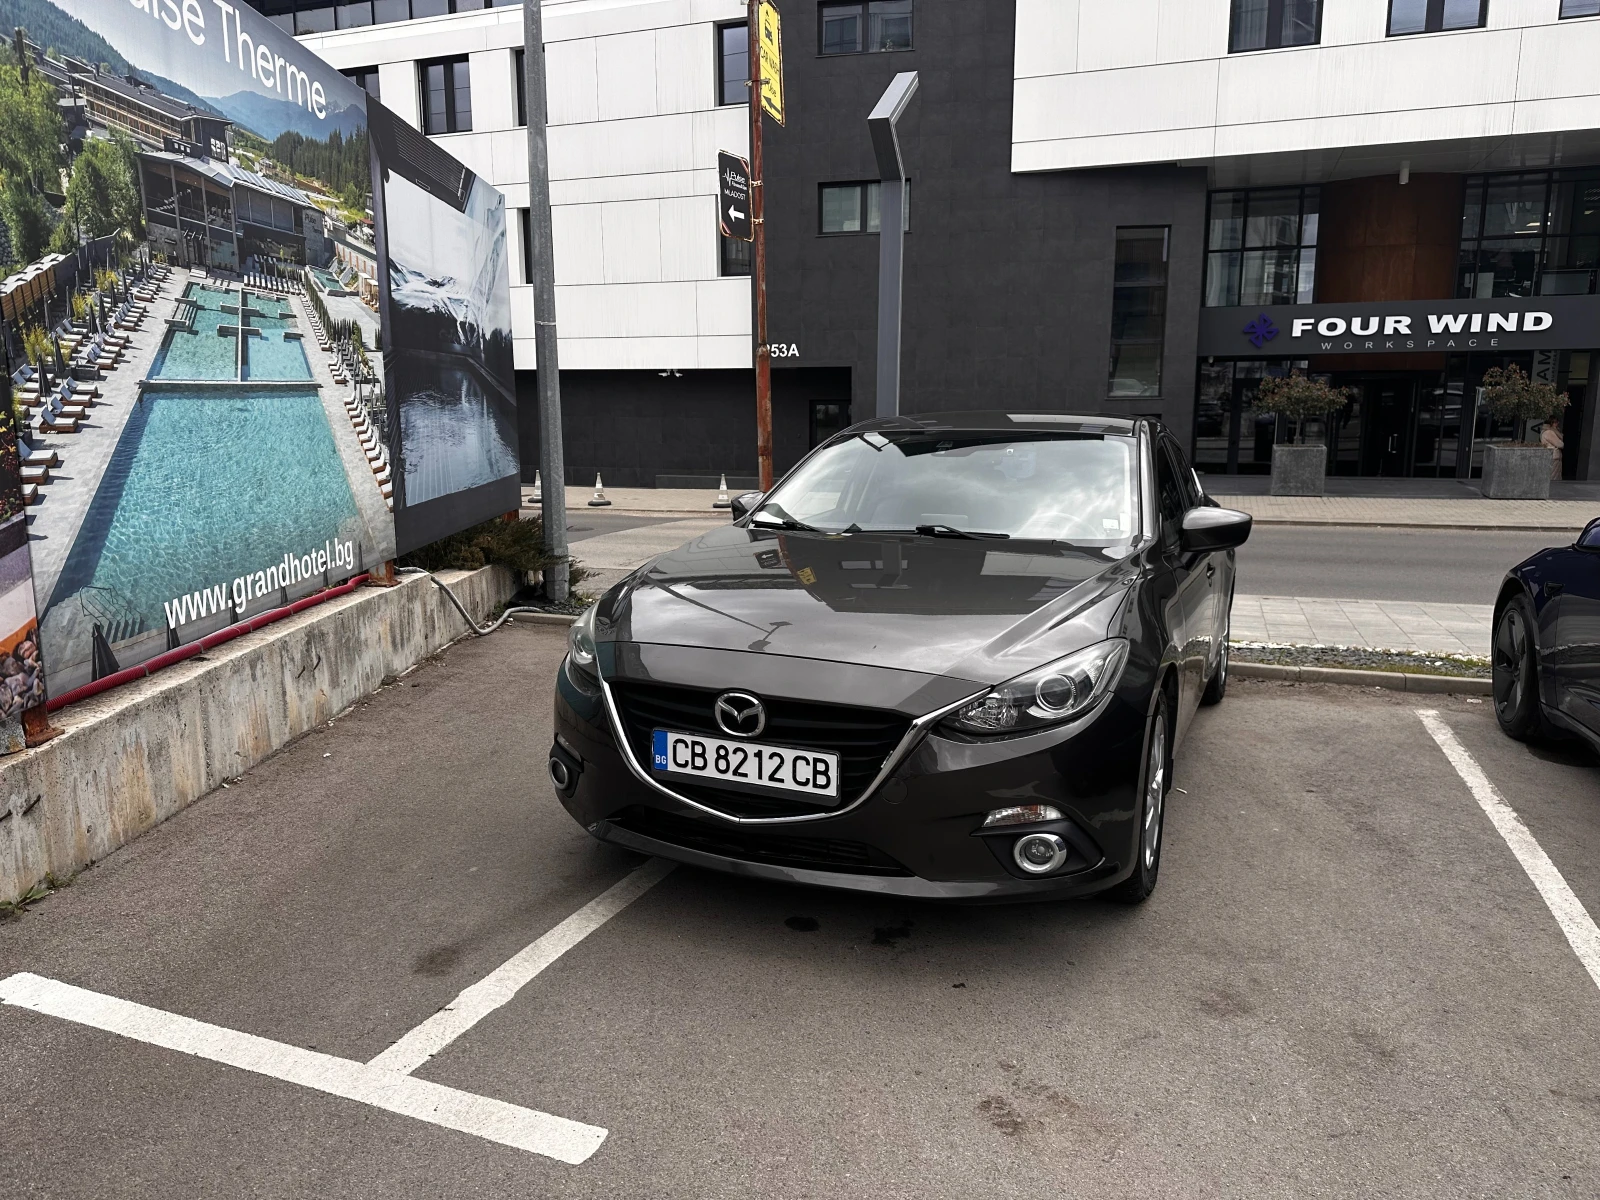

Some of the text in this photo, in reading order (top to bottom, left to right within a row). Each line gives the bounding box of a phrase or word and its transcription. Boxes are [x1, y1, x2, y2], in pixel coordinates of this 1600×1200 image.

[213, 0, 326, 120] Therme
[724, 188, 746, 200] MLADOST
[1292, 312, 1553, 337] FOUR WIND
[1321, 339, 1499, 350] WORKSPACE
[163, 537, 355, 630] www.grandhotel.bg
[655, 754, 667, 765] BG
[672, 738, 832, 790] CB 8212 CB
